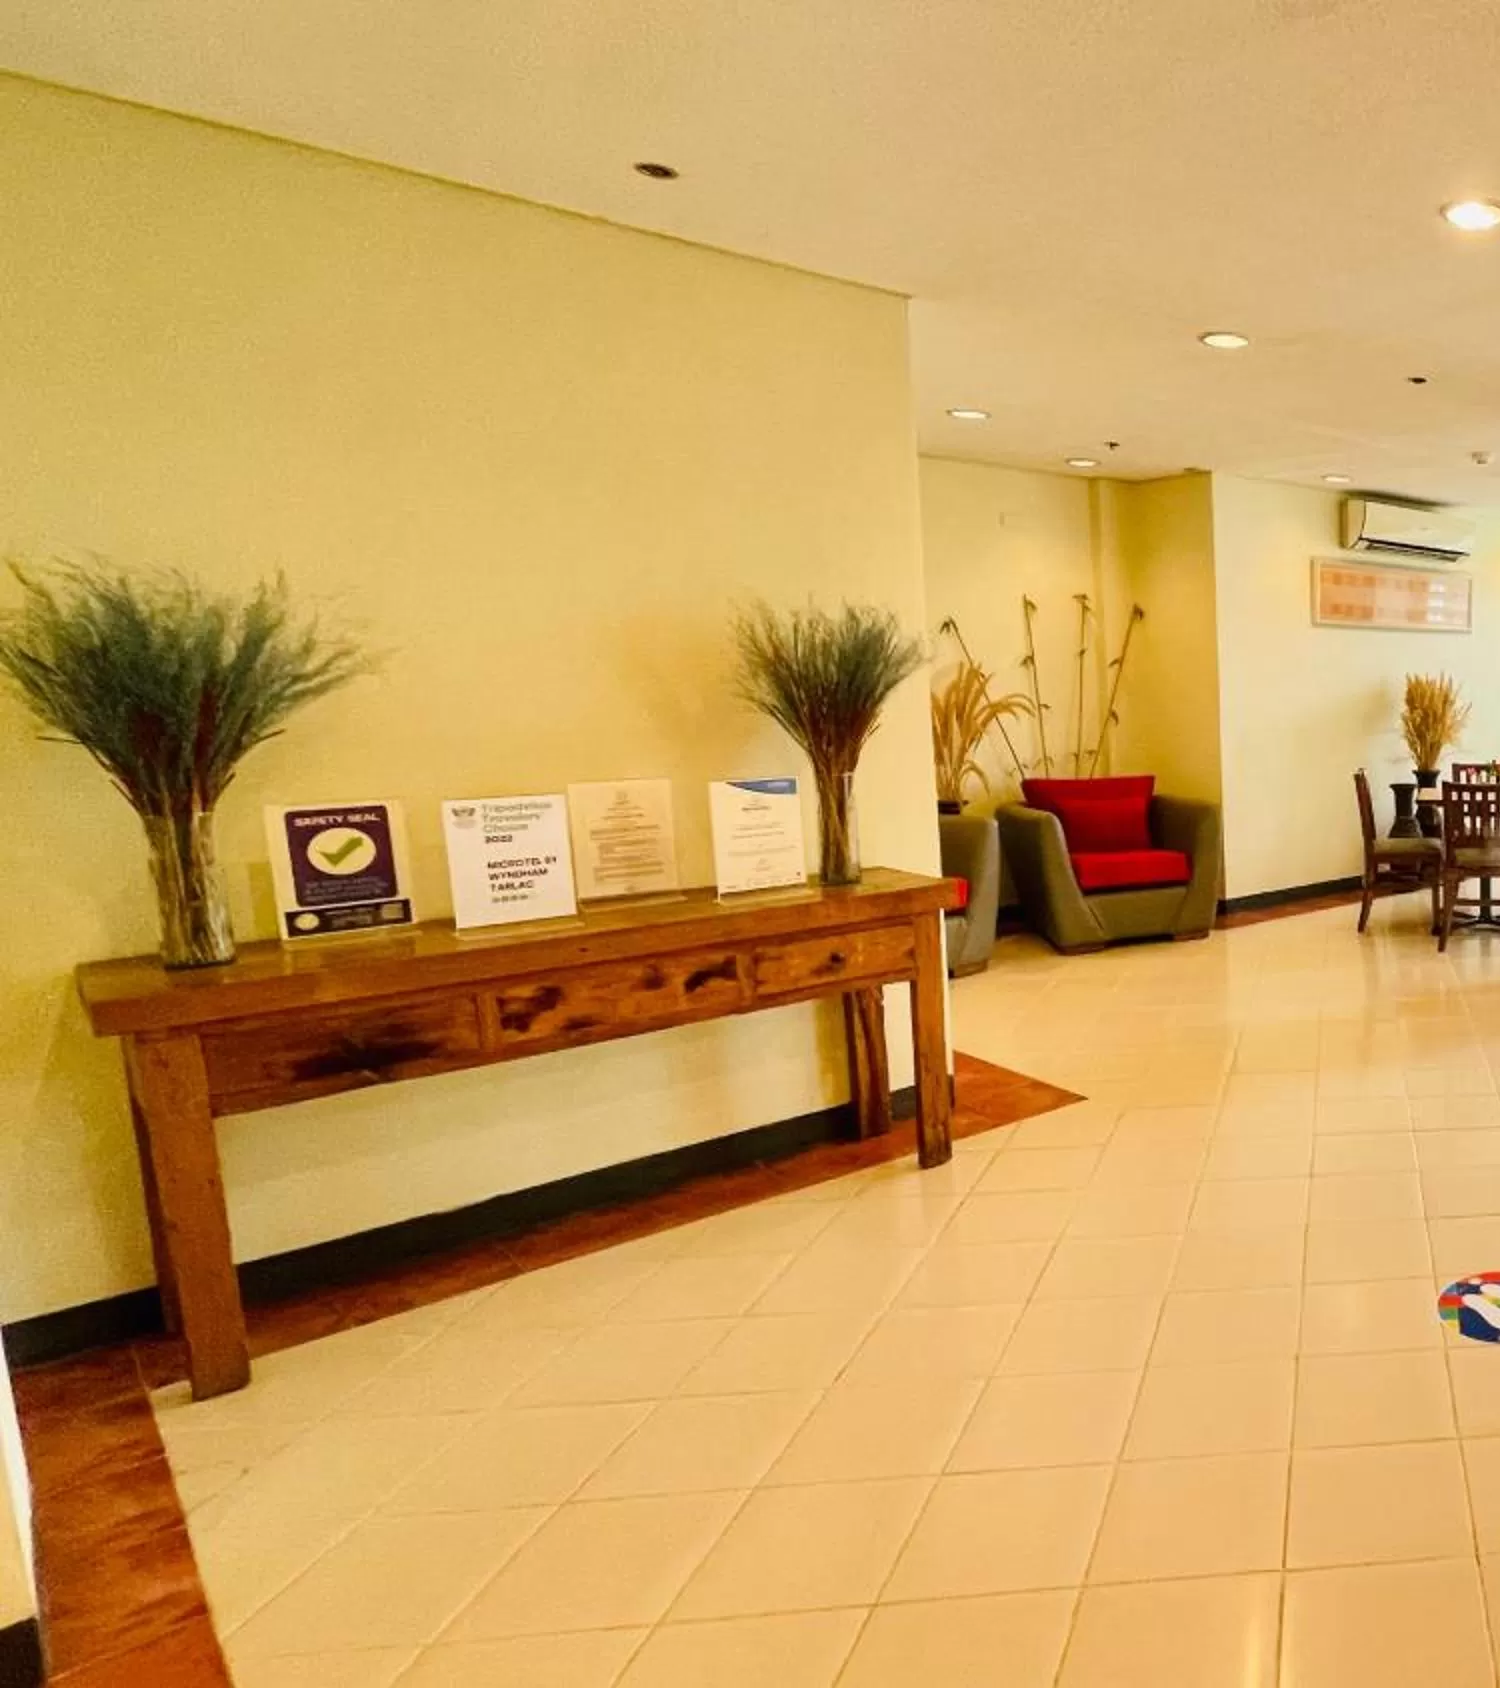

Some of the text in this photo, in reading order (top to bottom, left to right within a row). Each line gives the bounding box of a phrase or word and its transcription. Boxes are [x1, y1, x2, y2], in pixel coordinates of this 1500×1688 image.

[293, 812, 381, 827] SAFETY SEAL
[487, 855, 557, 869] MICROTEL BY
[488, 867, 549, 880] WYNDHAM
[490, 880, 534, 892] TARLAC
